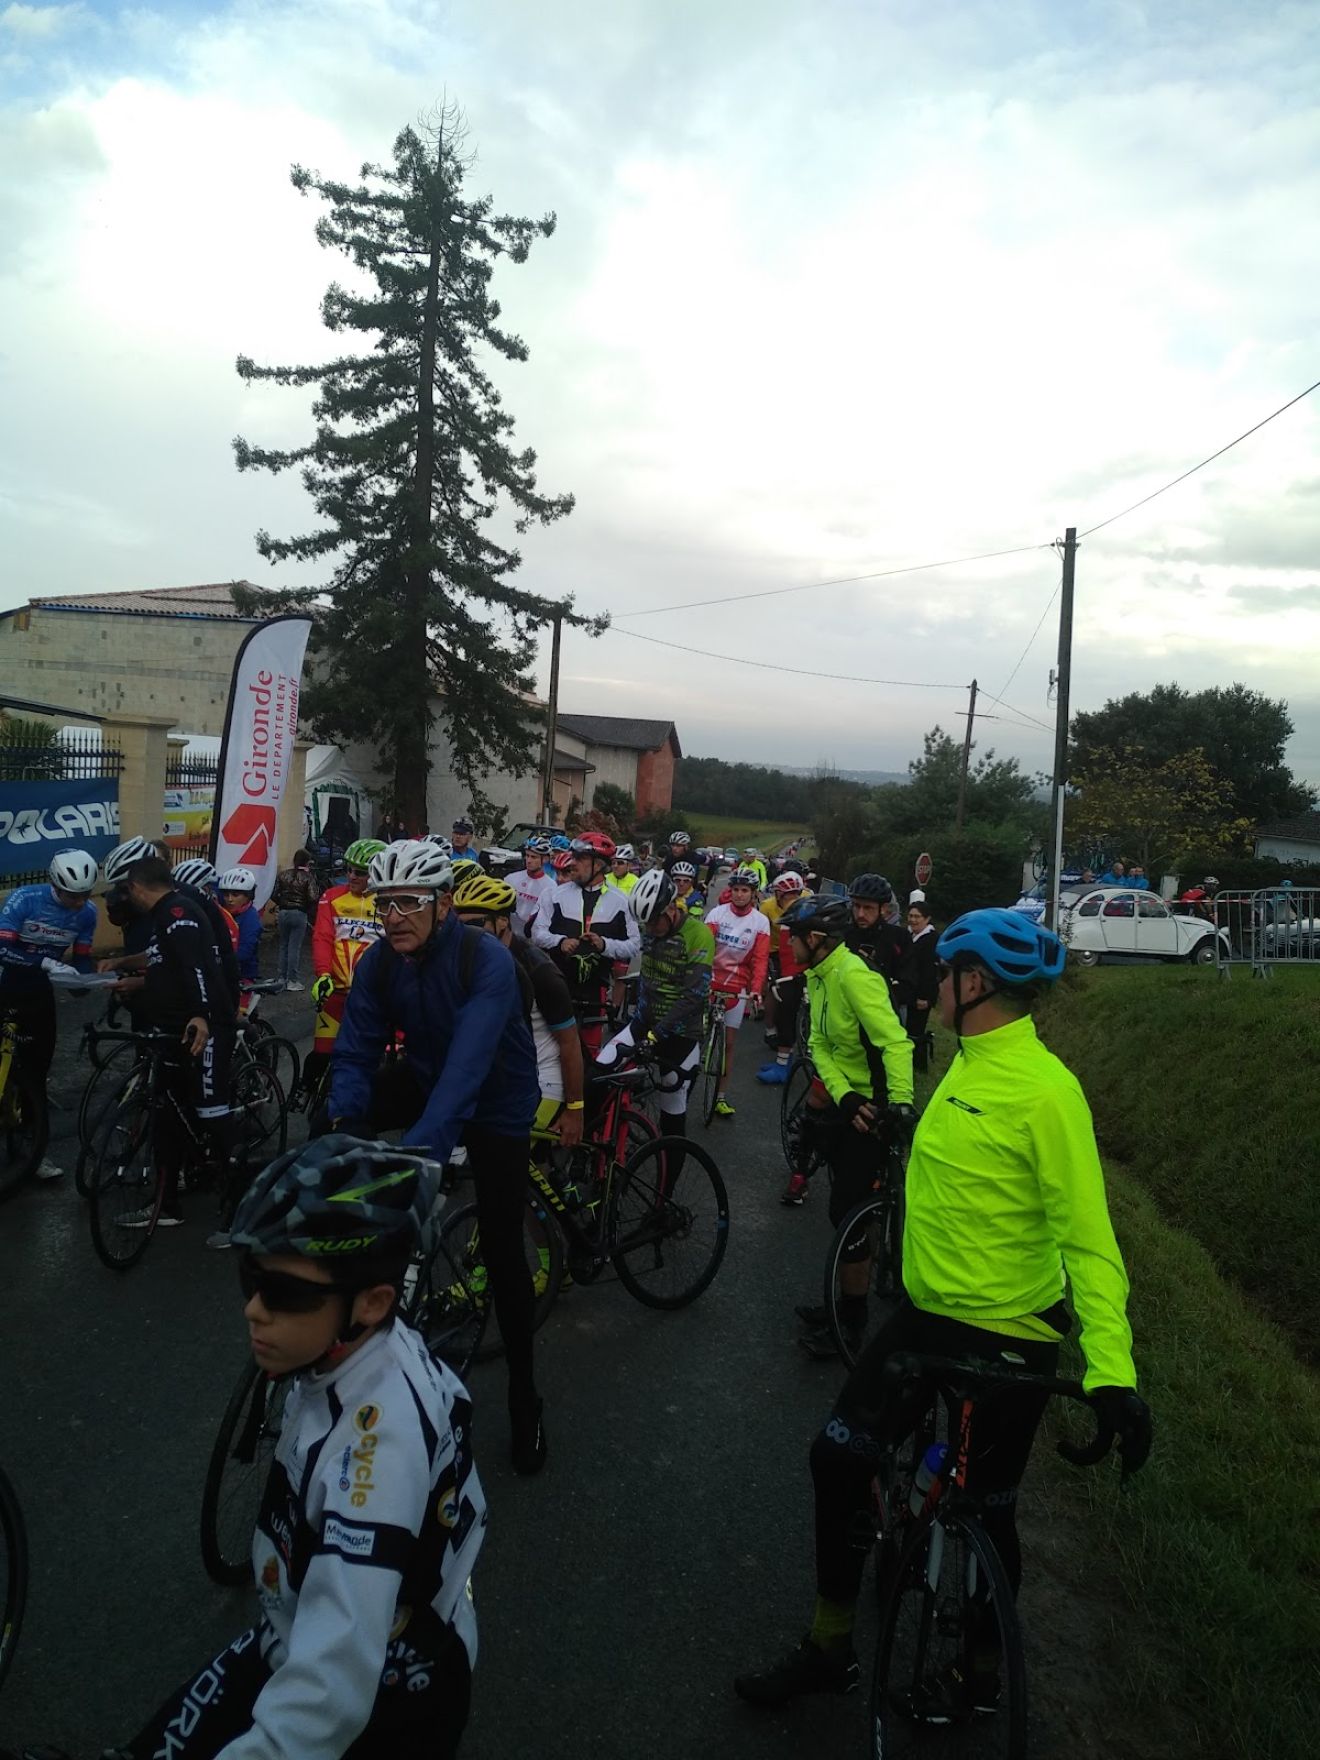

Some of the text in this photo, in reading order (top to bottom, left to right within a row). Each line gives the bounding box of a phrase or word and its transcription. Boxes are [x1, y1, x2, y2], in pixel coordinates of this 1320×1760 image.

[242, 670, 273, 797] Gironde
[271, 673, 287, 800] LE DEPARTEMENT
[287, 677, 299, 736] gironde.fr
[202, 1036, 216, 1099] TREK
[305, 1233, 379, 1252] RUDY
[351, 1434, 379, 1508] cycle
